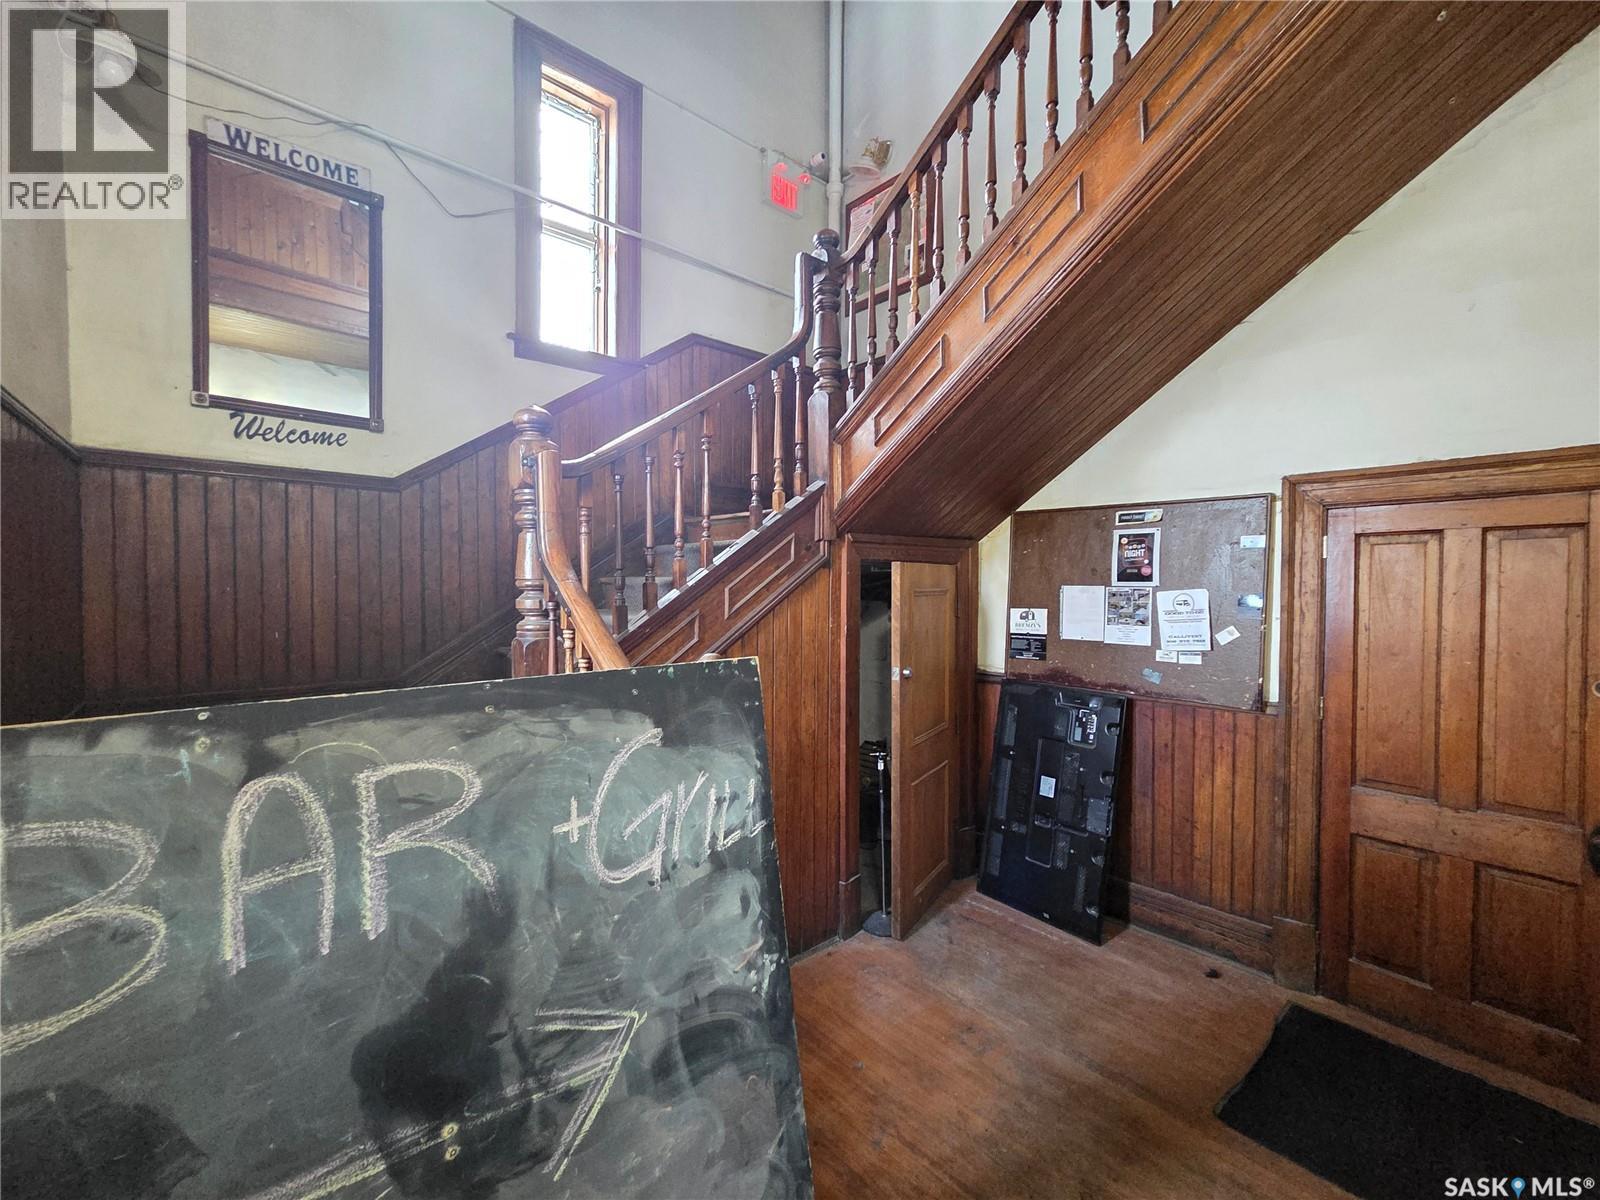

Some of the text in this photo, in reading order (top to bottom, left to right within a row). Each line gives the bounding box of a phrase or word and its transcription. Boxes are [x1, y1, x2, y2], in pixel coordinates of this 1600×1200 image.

[223, 123, 359, 187] WELCOME
[229, 411, 348, 447] Welcome
[1124, 548, 1146, 558] NIGHT
[0, 758, 497, 1056] BAR
